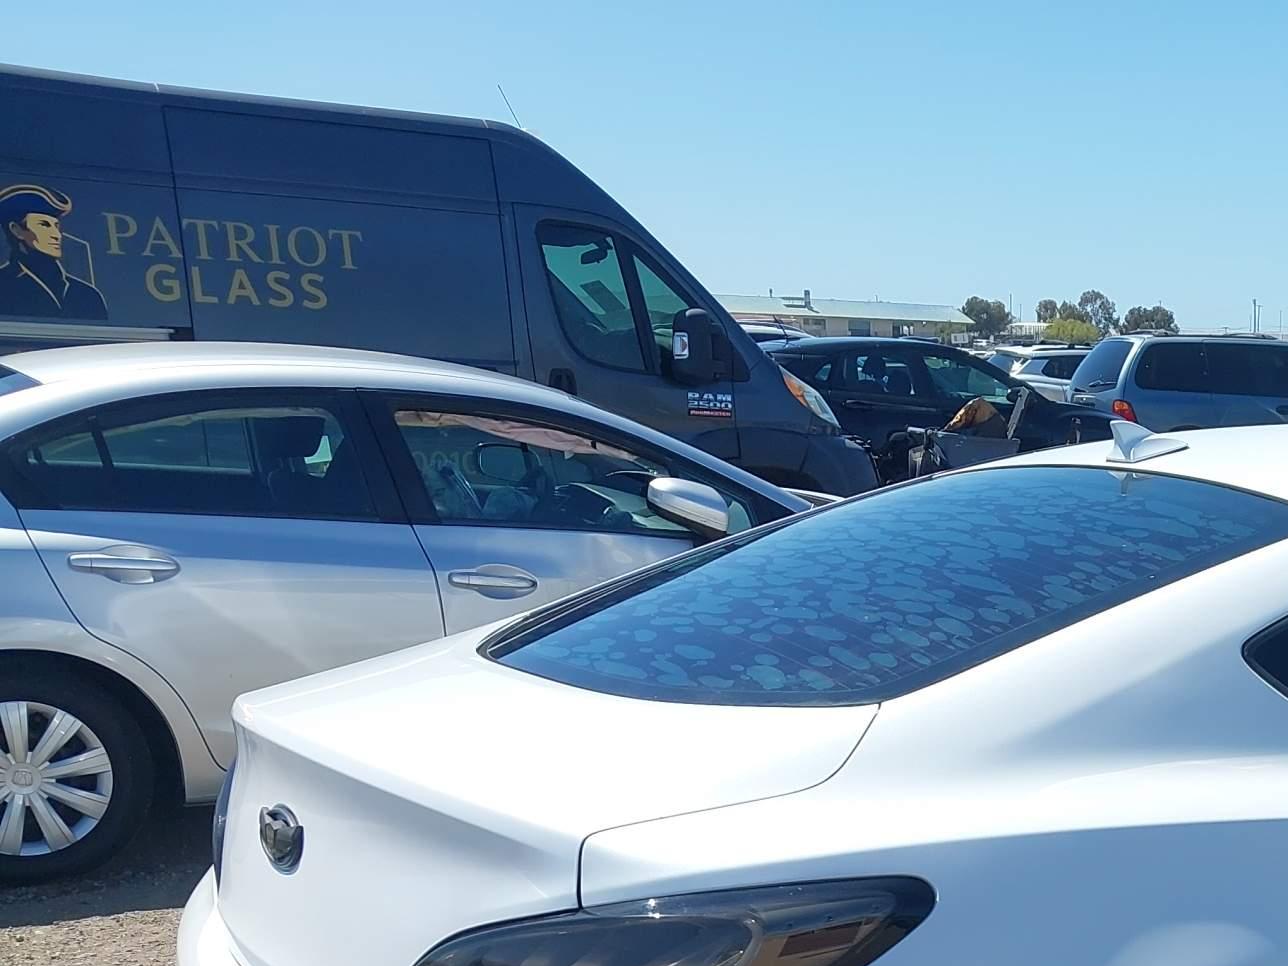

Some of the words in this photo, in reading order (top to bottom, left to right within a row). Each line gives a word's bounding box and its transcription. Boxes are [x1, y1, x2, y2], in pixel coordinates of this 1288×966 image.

[102, 211, 364, 270] PATRIOT
[145, 263, 328, 310] GLASS
[687, 391, 732, 401] RAM
[687, 400, 732, 410] 2500
